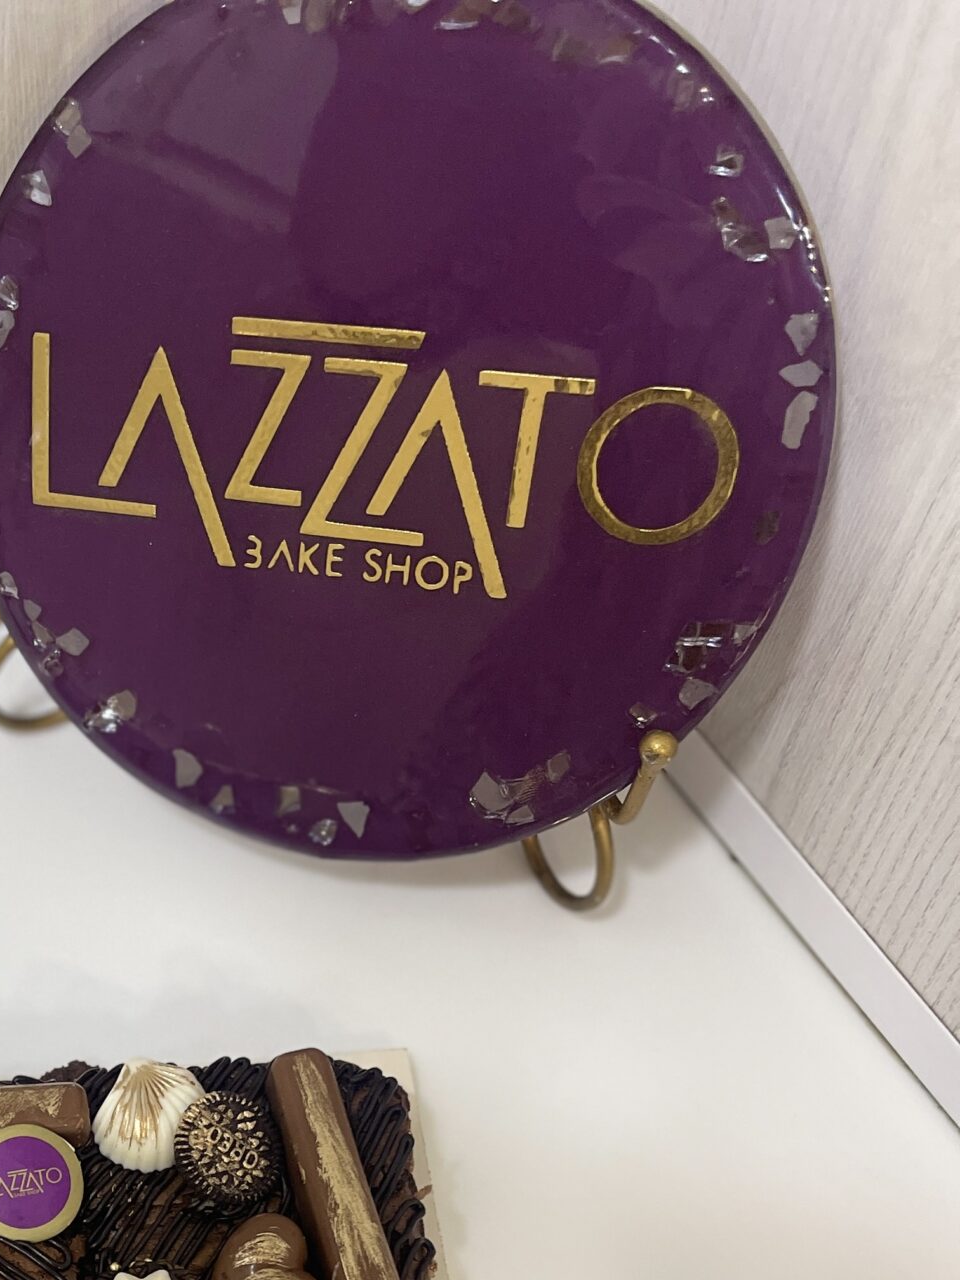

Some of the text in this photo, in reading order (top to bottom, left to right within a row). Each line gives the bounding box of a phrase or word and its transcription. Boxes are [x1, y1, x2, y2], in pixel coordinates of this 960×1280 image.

[32, 316, 739, 599] LAZZATO
[244, 535, 473, 595] BAKE SHOP
